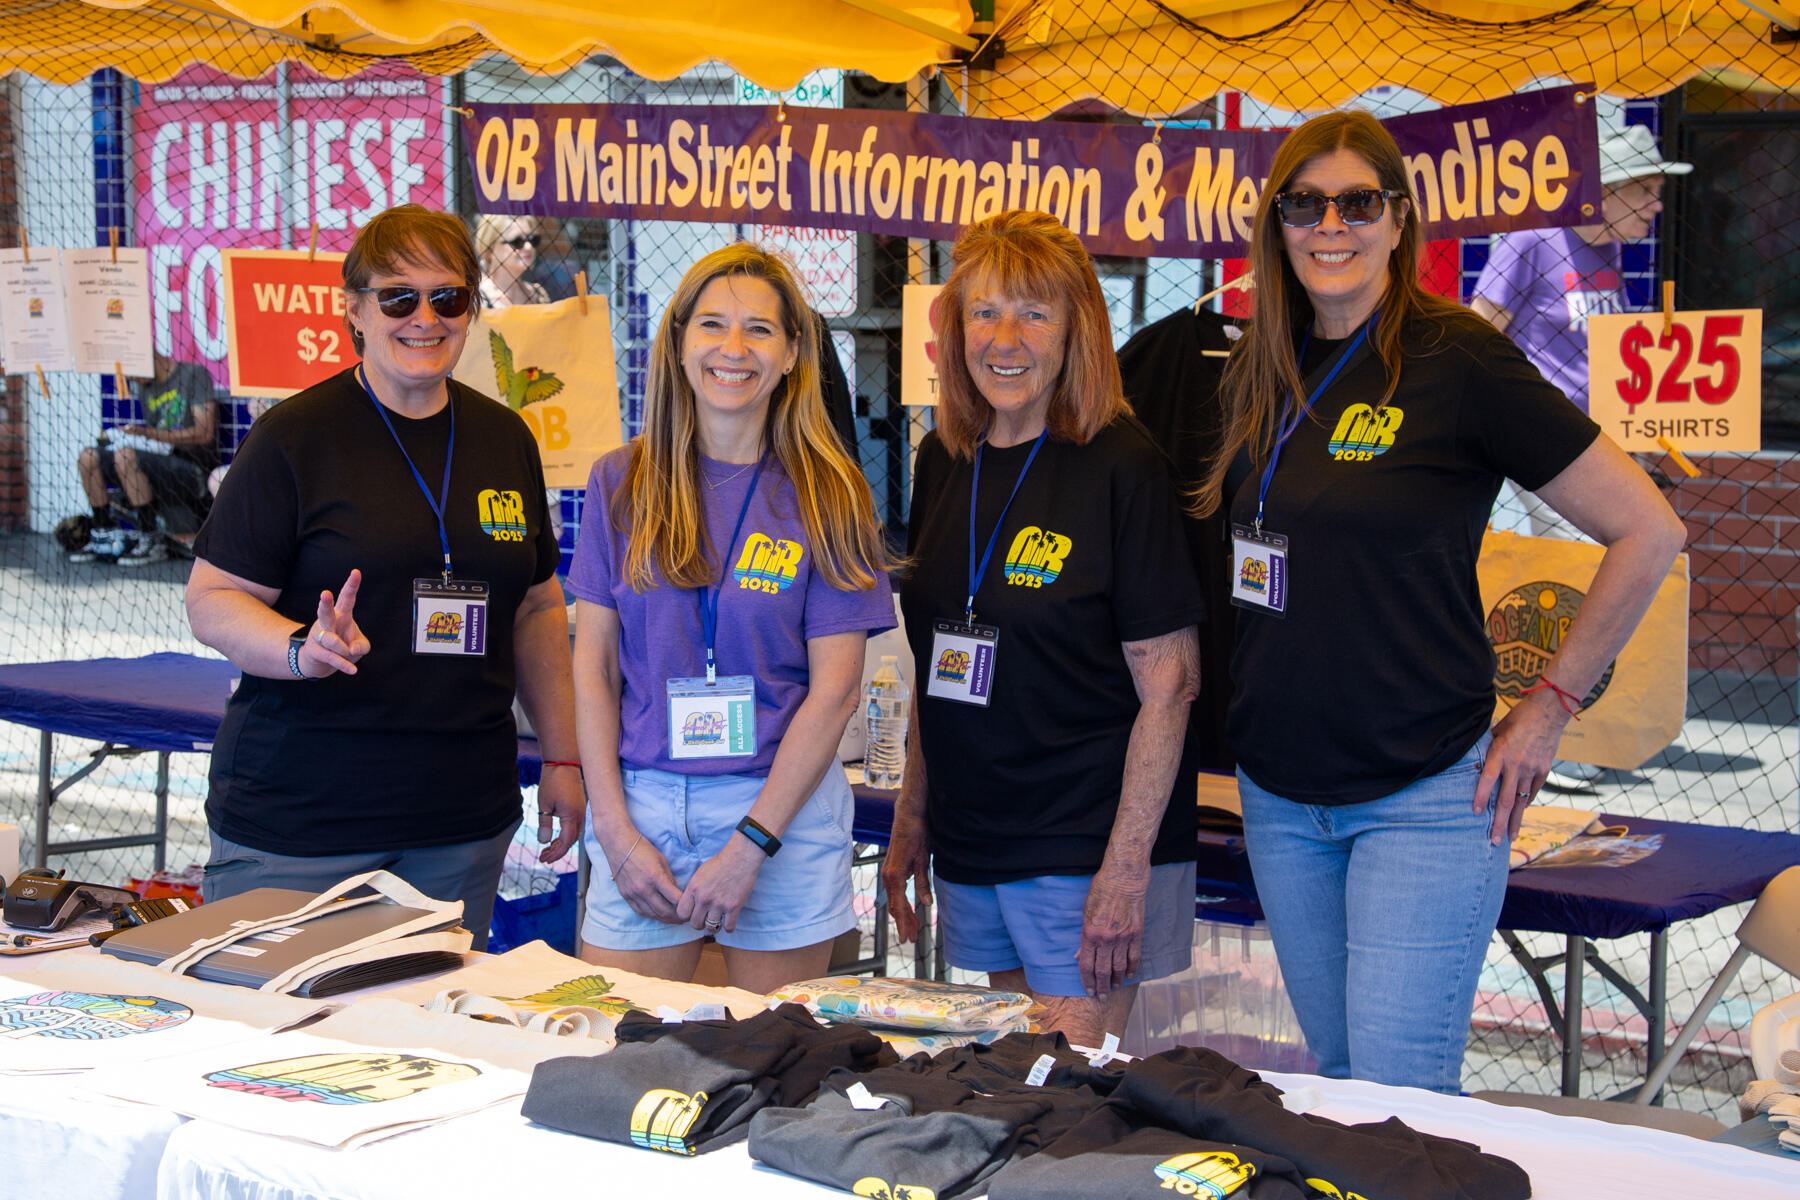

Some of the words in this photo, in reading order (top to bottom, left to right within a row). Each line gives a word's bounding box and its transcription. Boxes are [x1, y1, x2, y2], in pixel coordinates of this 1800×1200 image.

[151, 118, 426, 229] CHINESE
[476, 117, 540, 202] OB
[555, 118, 793, 211] MainStreet
[809, 124, 1102, 236] Information
[1125, 143, 1167, 241] &
[1186, 118, 1569, 243] Mendise
[253, 282, 346, 316] WATE
[296, 326, 341, 365] $2
[1616, 315, 1744, 415] $25
[1620, 418, 1730, 439] T-SHIRTS
[1334, 449, 1376, 462] 2025
[491, 529, 524, 543] 2025
[739, 575, 780, 595] 2025
[1007, 571, 1045, 589] 2025
[1272, 558, 1280, 605] VOLUNTEER
[471, 607, 479, 650] VOLUNTEER
[1490, 603, 1556, 651] OCEAN
[975, 647, 987, 693] VOLUNTEER
[1160, 1175, 1218, 1200] 202
